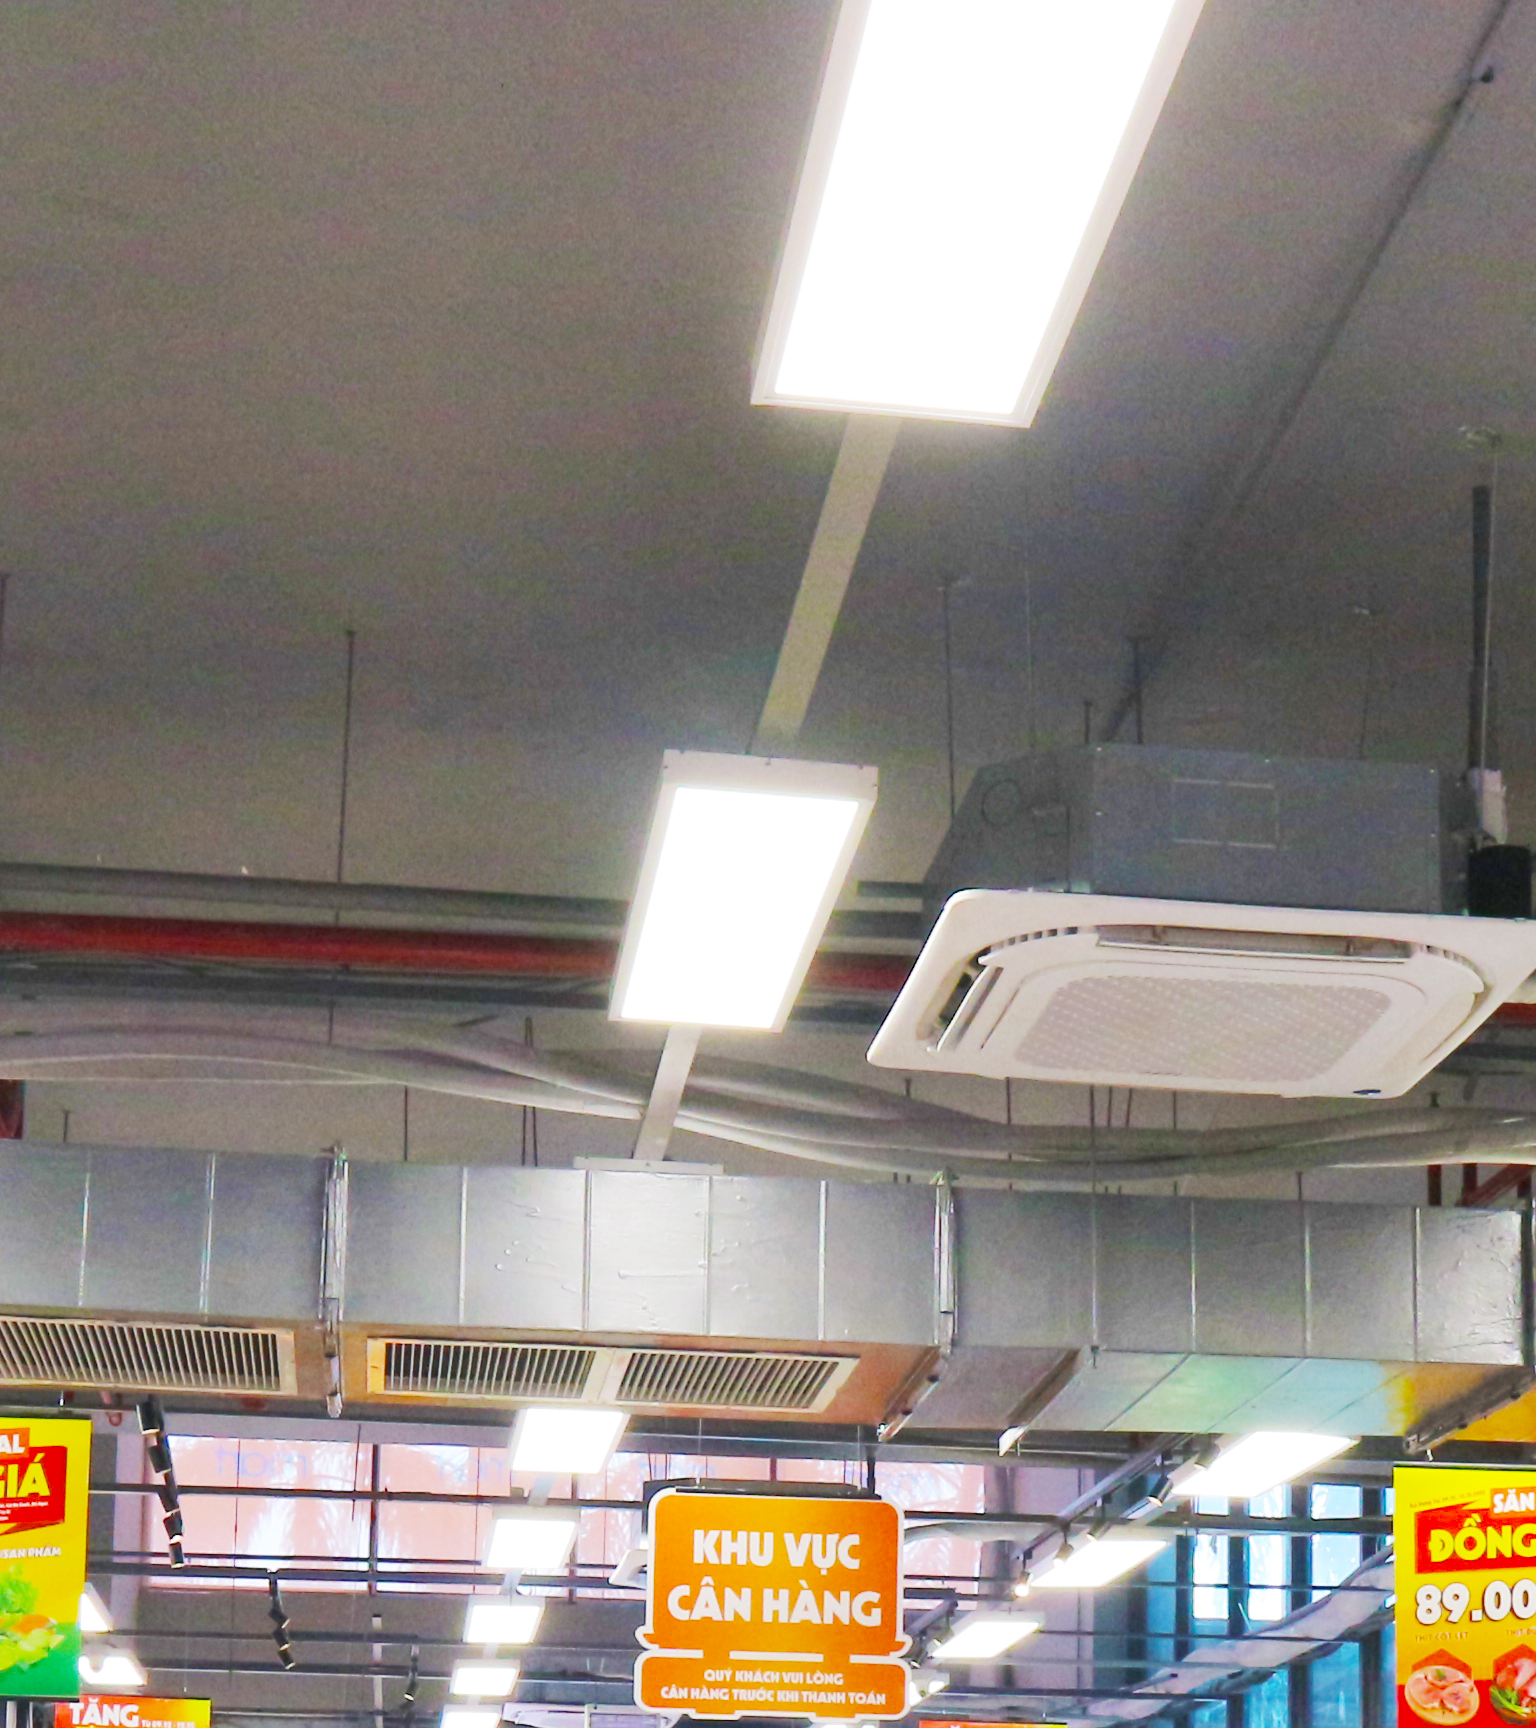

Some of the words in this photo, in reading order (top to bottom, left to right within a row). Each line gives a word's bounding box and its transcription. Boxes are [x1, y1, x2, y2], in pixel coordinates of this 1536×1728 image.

[1493, 1488, 1536, 1513] SĂN
[693, 1529, 774, 1566] KHU
[784, 1532, 861, 1575] VỰC
[667, 1576, 752, 1622] CÂN
[762, 1579, 882, 1627] HÀNG
[704, 1668, 732, 1682] QUÝ
[735, 1669, 780, 1684] KHÁCH
[782, 1672, 805, 1684] VUI
[806, 1670, 844, 1685] LÒNG
[661, 1684, 689, 1700] CÂN
[691, 1686, 730, 1701] HÀNG
[777, 1691, 799, 1703] KHI
[801, 1691, 846, 1704] THANH
[849, 1690, 886, 1705] TOÁN
